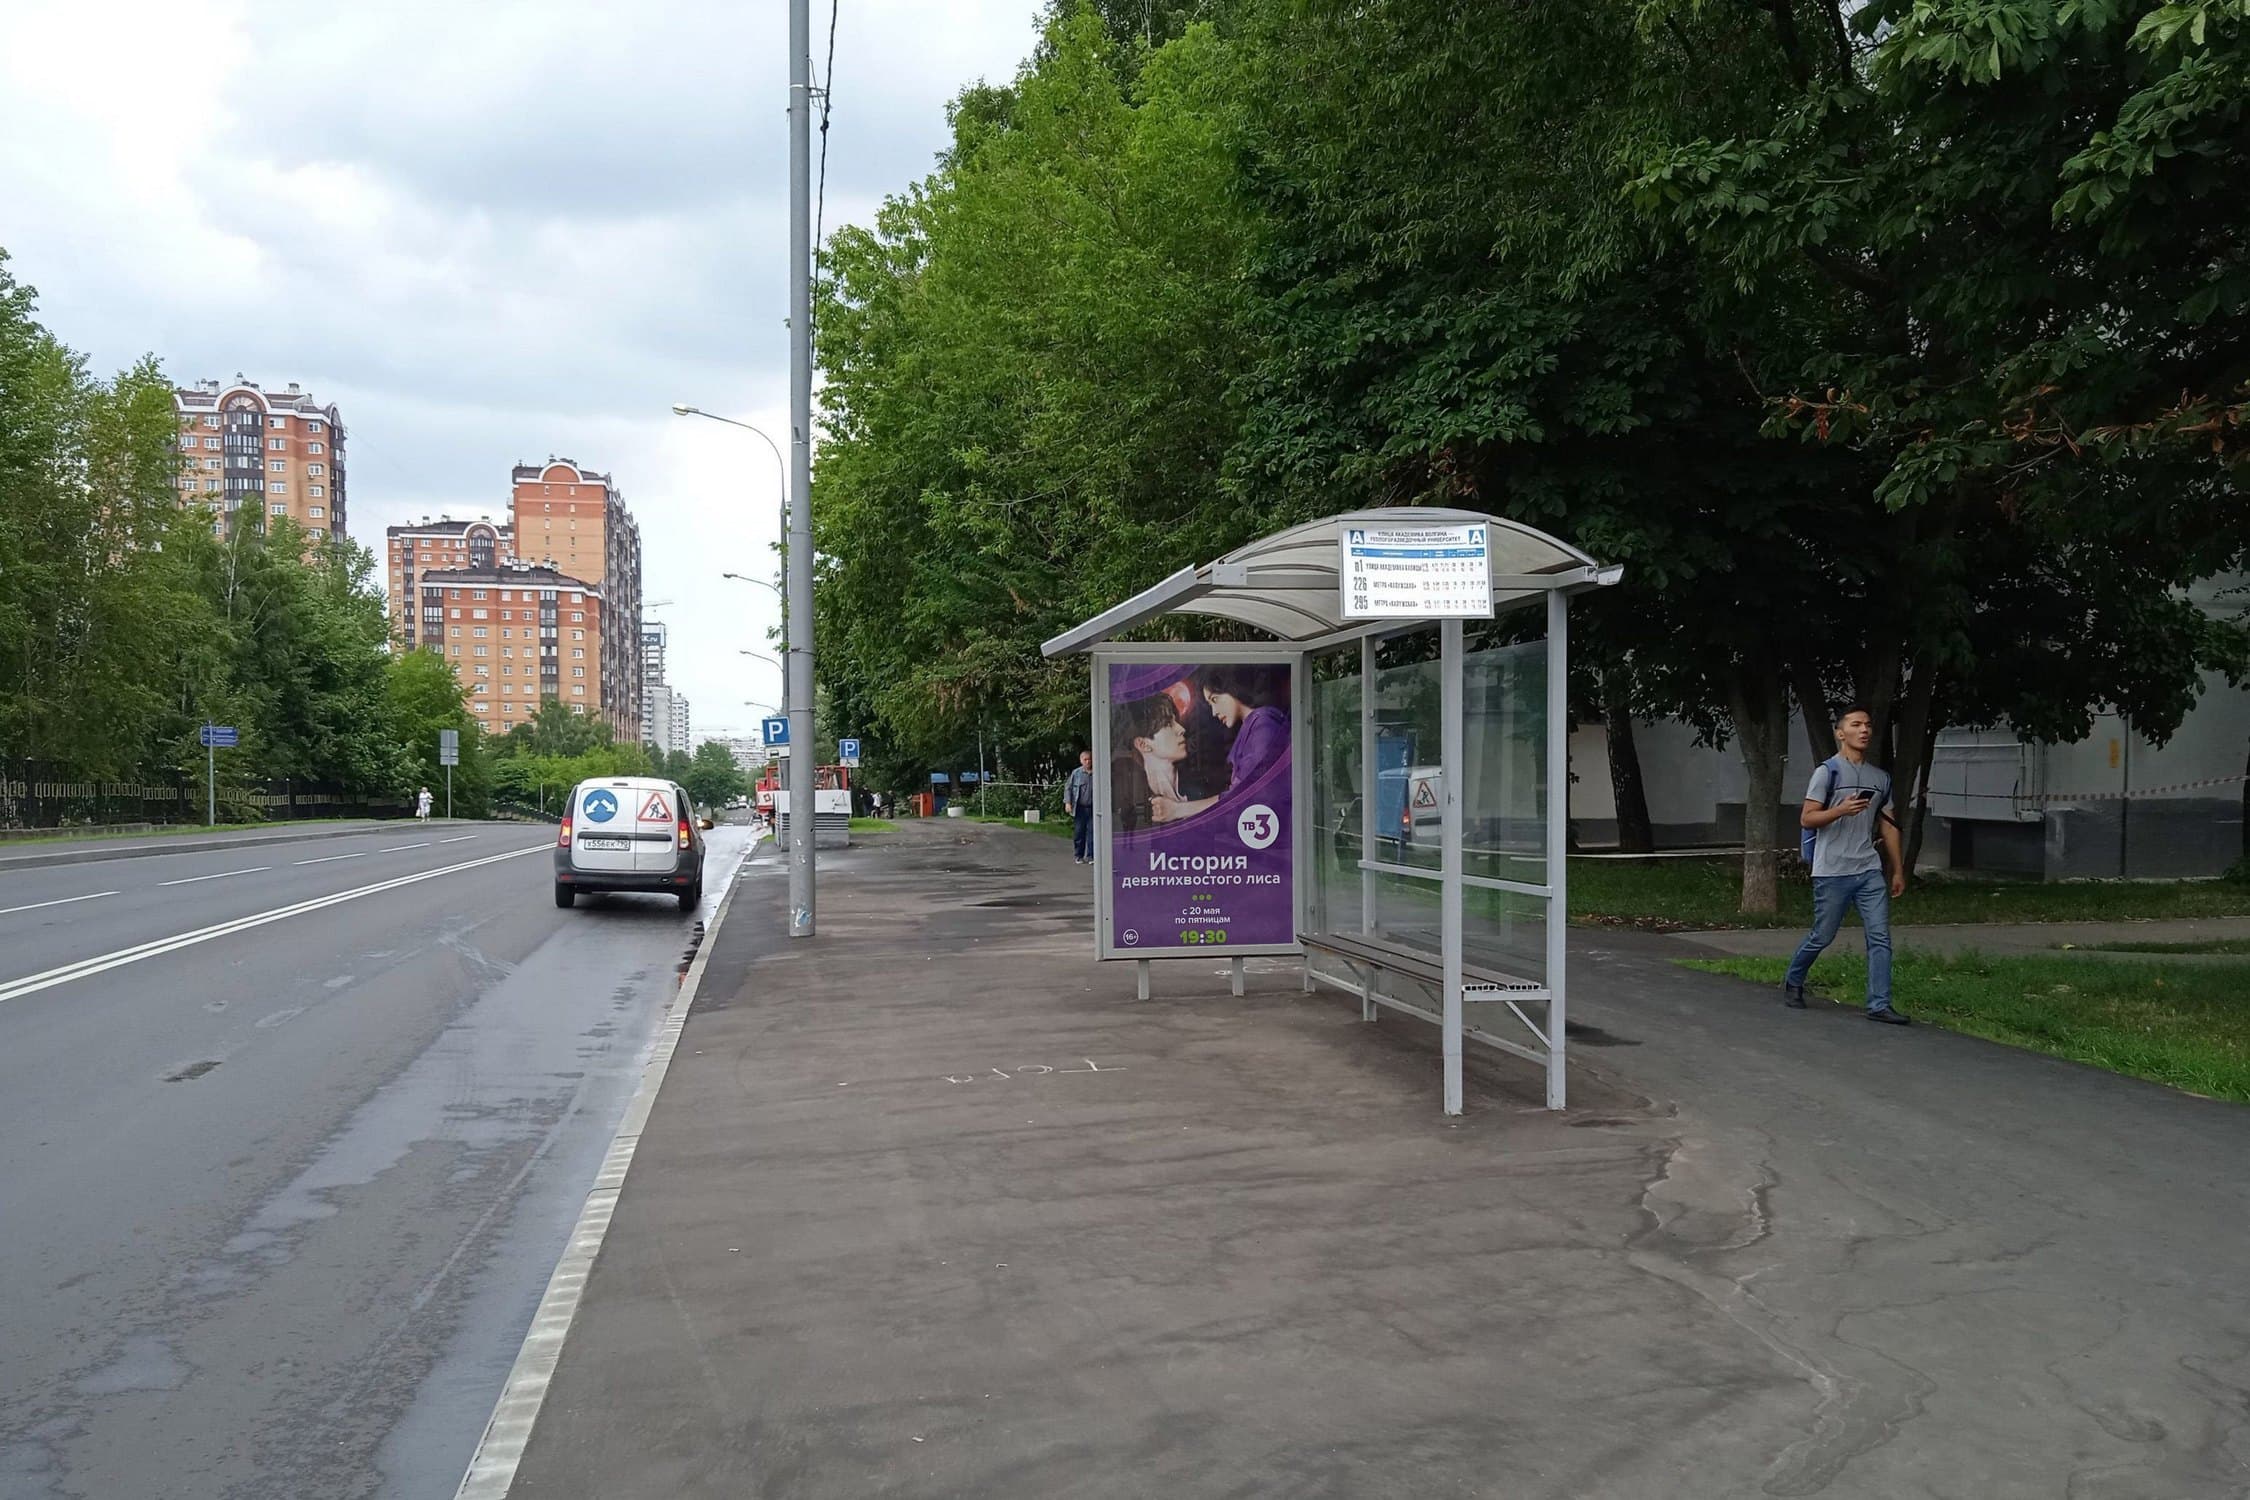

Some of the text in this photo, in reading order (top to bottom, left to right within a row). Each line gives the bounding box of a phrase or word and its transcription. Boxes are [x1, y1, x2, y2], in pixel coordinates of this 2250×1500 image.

[1353, 576, 1367, 591] 226
[1354, 595, 1368, 610] 295
[768, 721, 783, 742] P
[845, 742, 855, 756] P
[1150, 852, 1248, 874] История
[1122, 874, 1281, 888] девятихвостого лиса
[1190, 907, 1201, 915] 20
[1188, 916, 1231, 924] пятницам
[1180, 930, 1227, 944] 19:30
